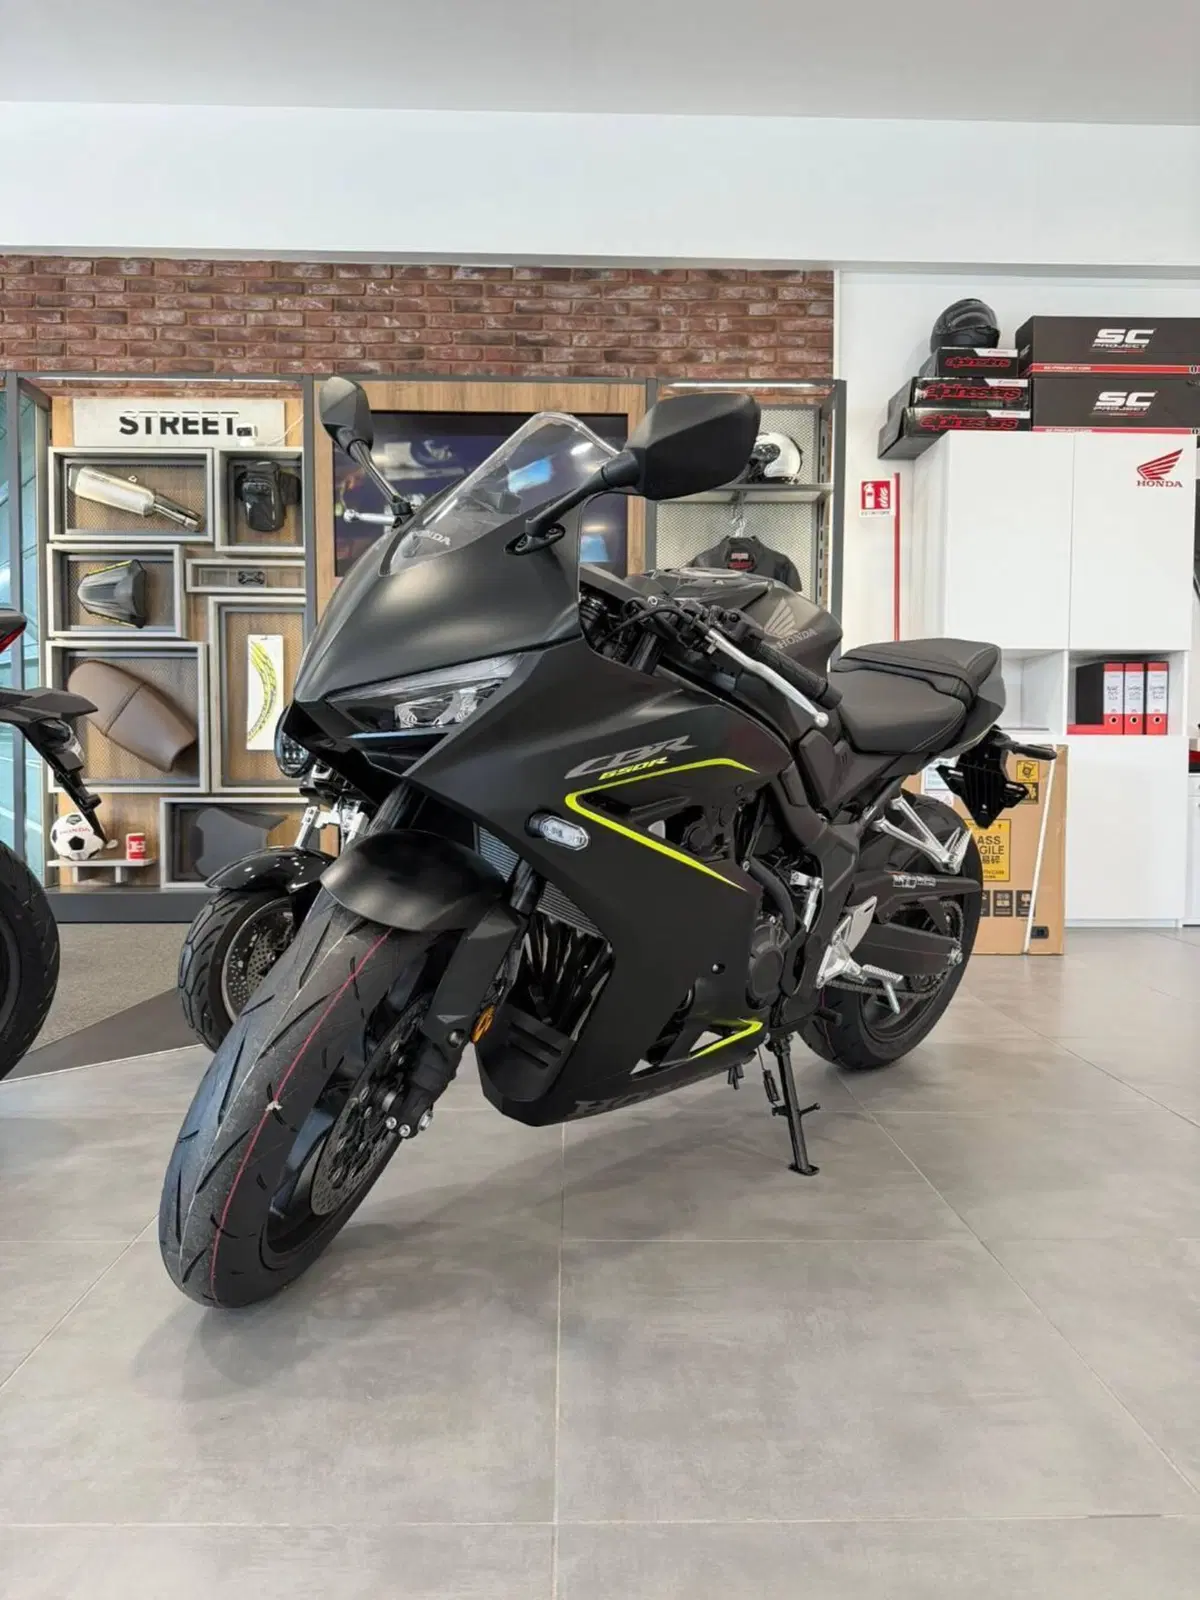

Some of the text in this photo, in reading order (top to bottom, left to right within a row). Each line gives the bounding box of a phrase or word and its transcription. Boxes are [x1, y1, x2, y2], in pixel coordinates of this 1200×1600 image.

[1094, 328, 1155, 344] SC
[1095, 391, 1157, 407] SC
[118, 411, 240, 436] STREET
[1136, 480, 1183, 488] HONDA
[776, 627, 818, 650] HONDA
[564, 734, 699, 779] CBR
[598, 756, 669, 781] 650R
[977, 835, 1001, 845] ASS
[979, 845, 1005, 855] GILE
